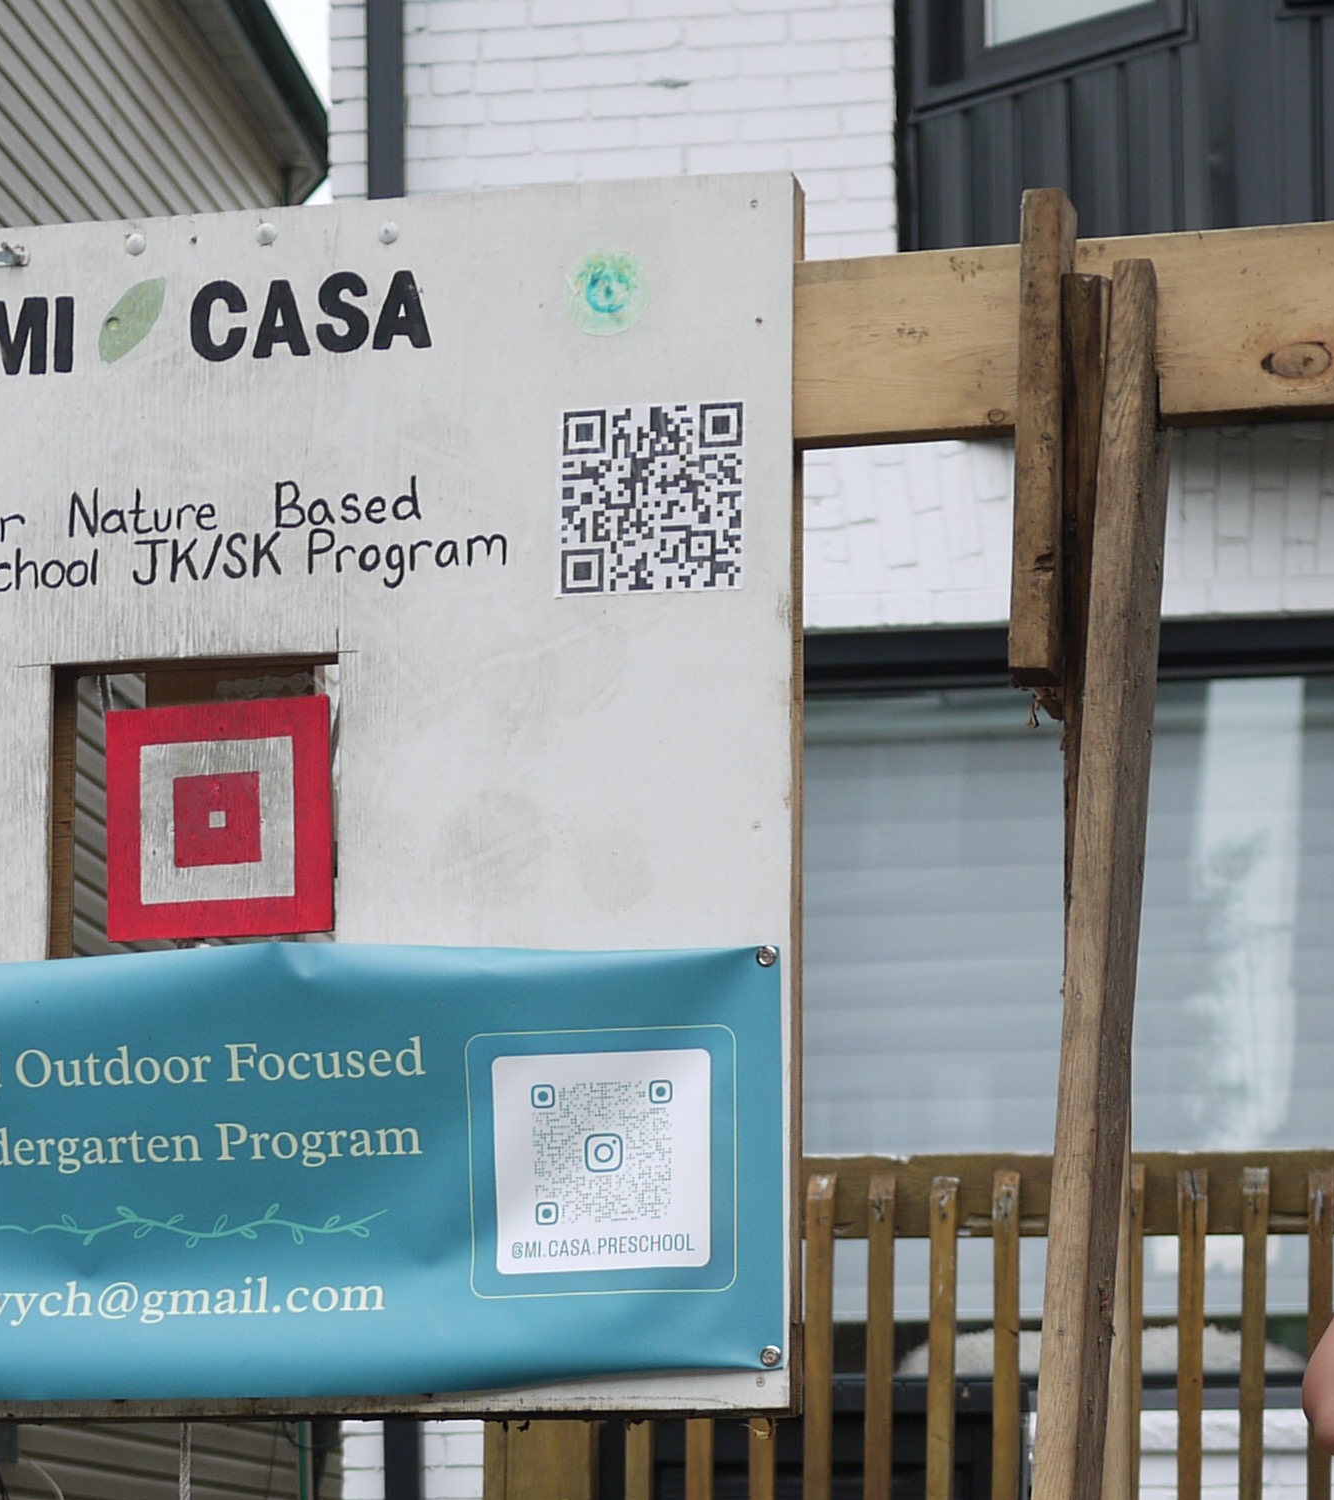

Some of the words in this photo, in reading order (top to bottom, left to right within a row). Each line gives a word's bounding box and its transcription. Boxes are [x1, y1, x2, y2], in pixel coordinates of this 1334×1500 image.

[189, 270, 432, 363] CASA
[68, 487, 220, 539] Nature
[274, 475, 422, 530] Based
[132, 530, 283, 586] JK/SK
[307, 531, 508, 588] Program
[15, 1045, 212, 1088] Outdoor
[224, 1035, 427, 1082] Focused
[214, 1122, 423, 1168] Program
[511, 1234, 696, 1259] @MI.CASA.PRESCHOOL
